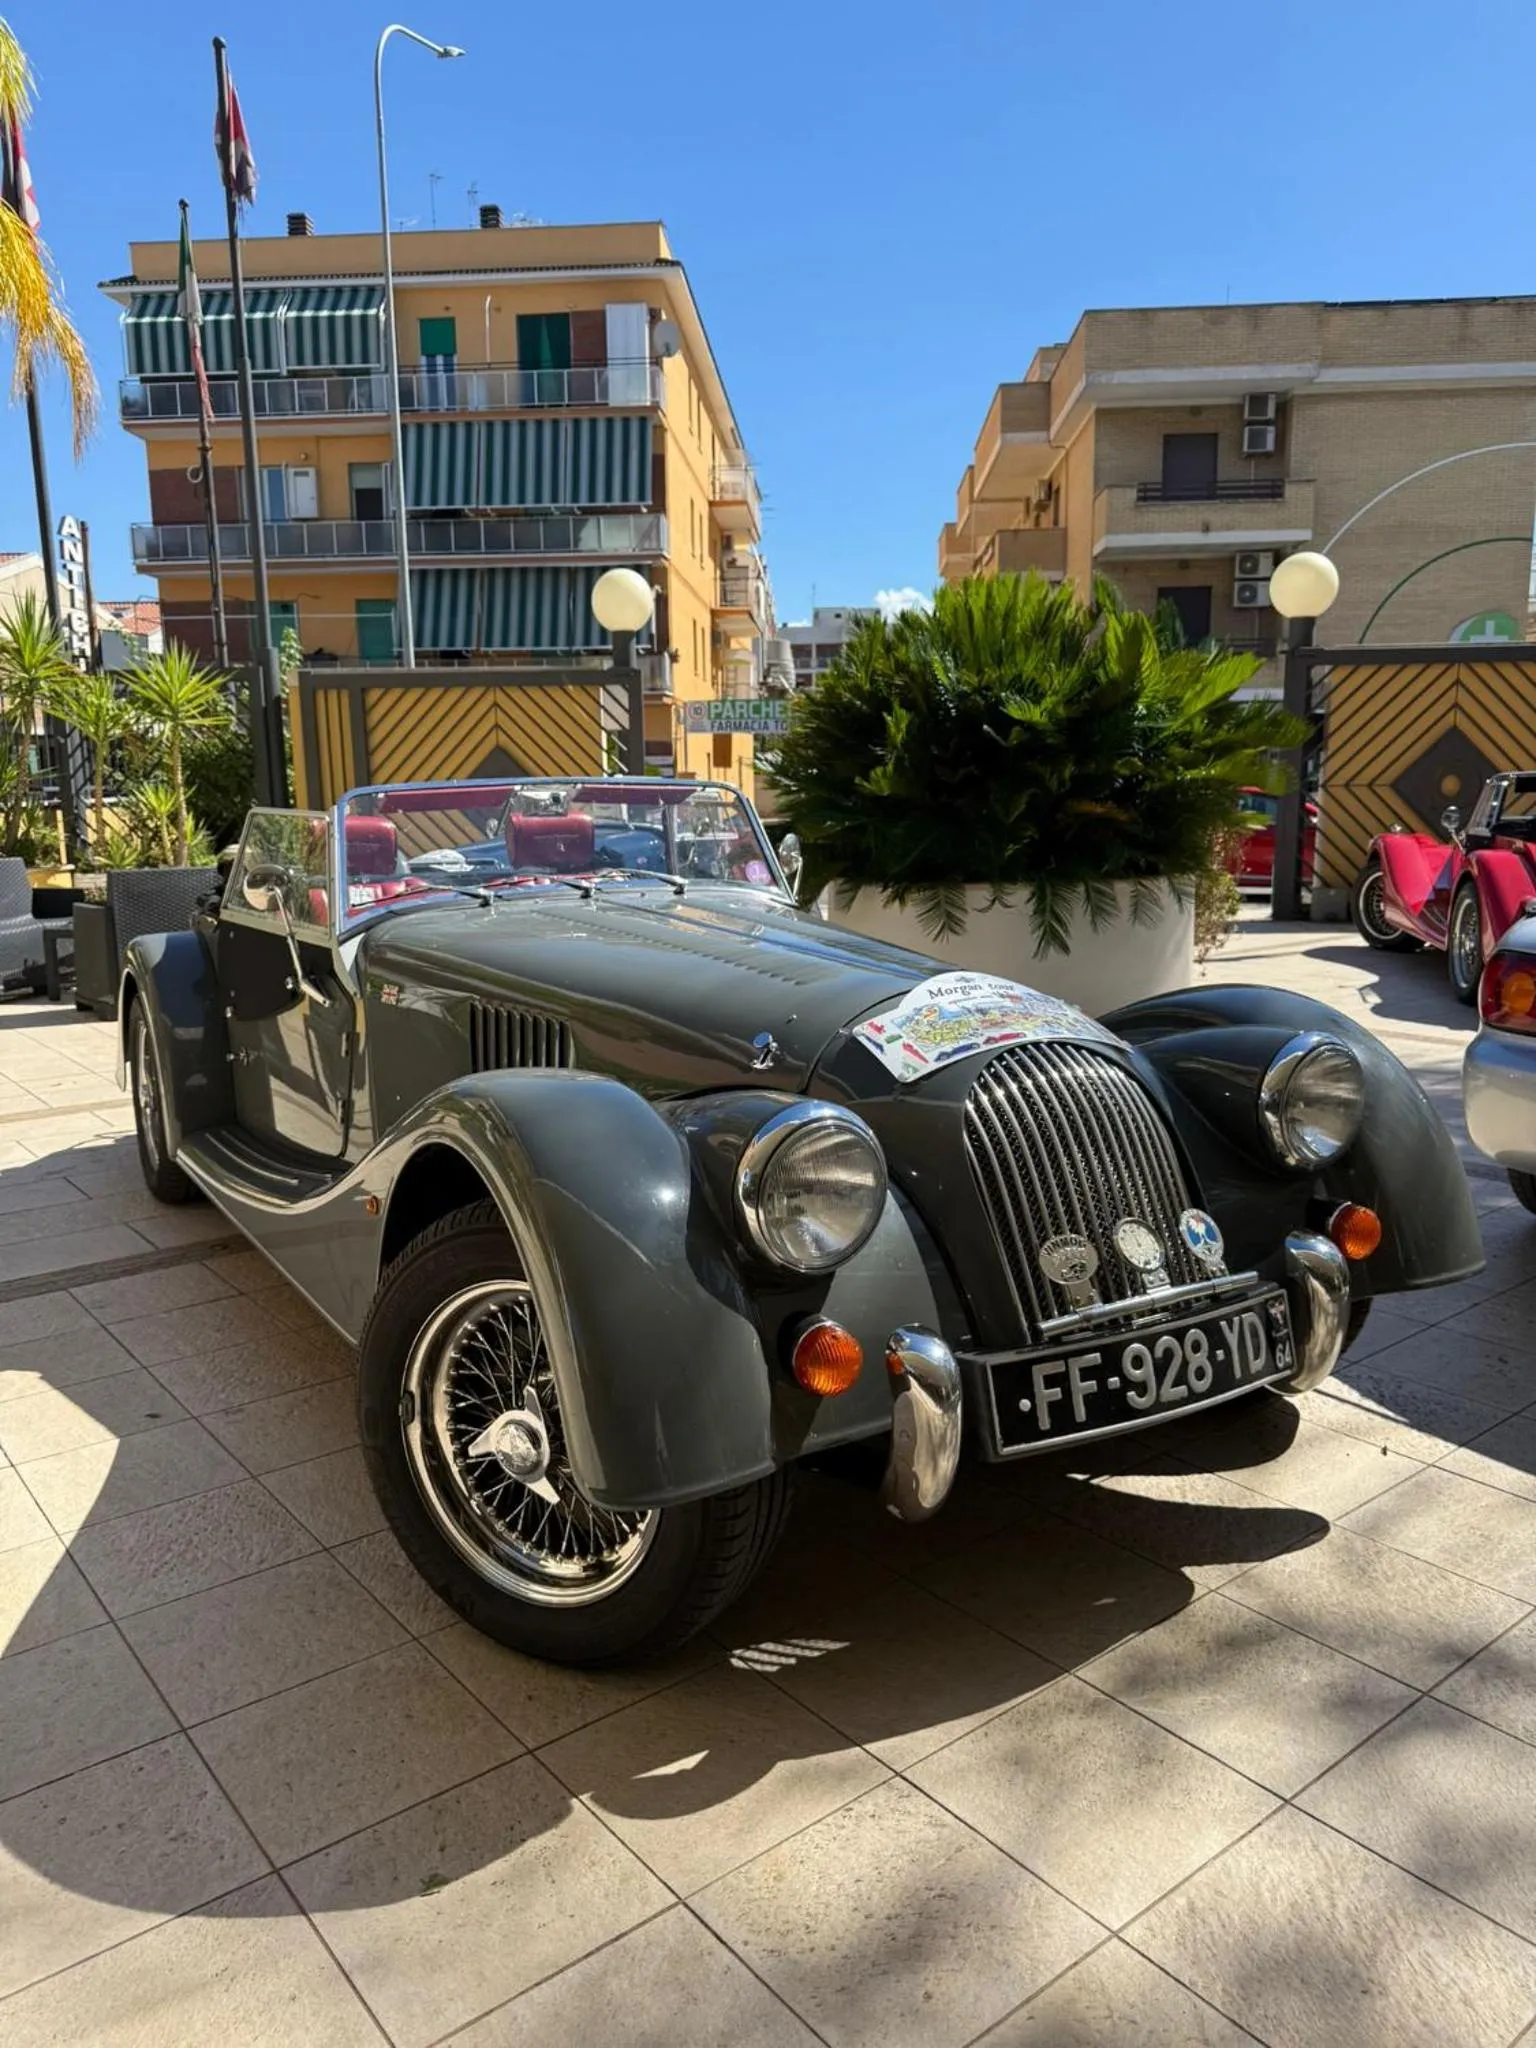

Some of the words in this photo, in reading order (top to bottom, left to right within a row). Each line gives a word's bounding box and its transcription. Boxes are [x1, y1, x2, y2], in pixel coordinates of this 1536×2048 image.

[710, 700, 787, 719] PARCHE
[711, 720, 770, 732] FARMACIA
[927, 984, 983, 1000] Morgan
[988, 983, 1015, 991] tour
[1275, 1341, 1293, 1369] 64
[1031, 1311, 1267, 1431] FF-928-YD
